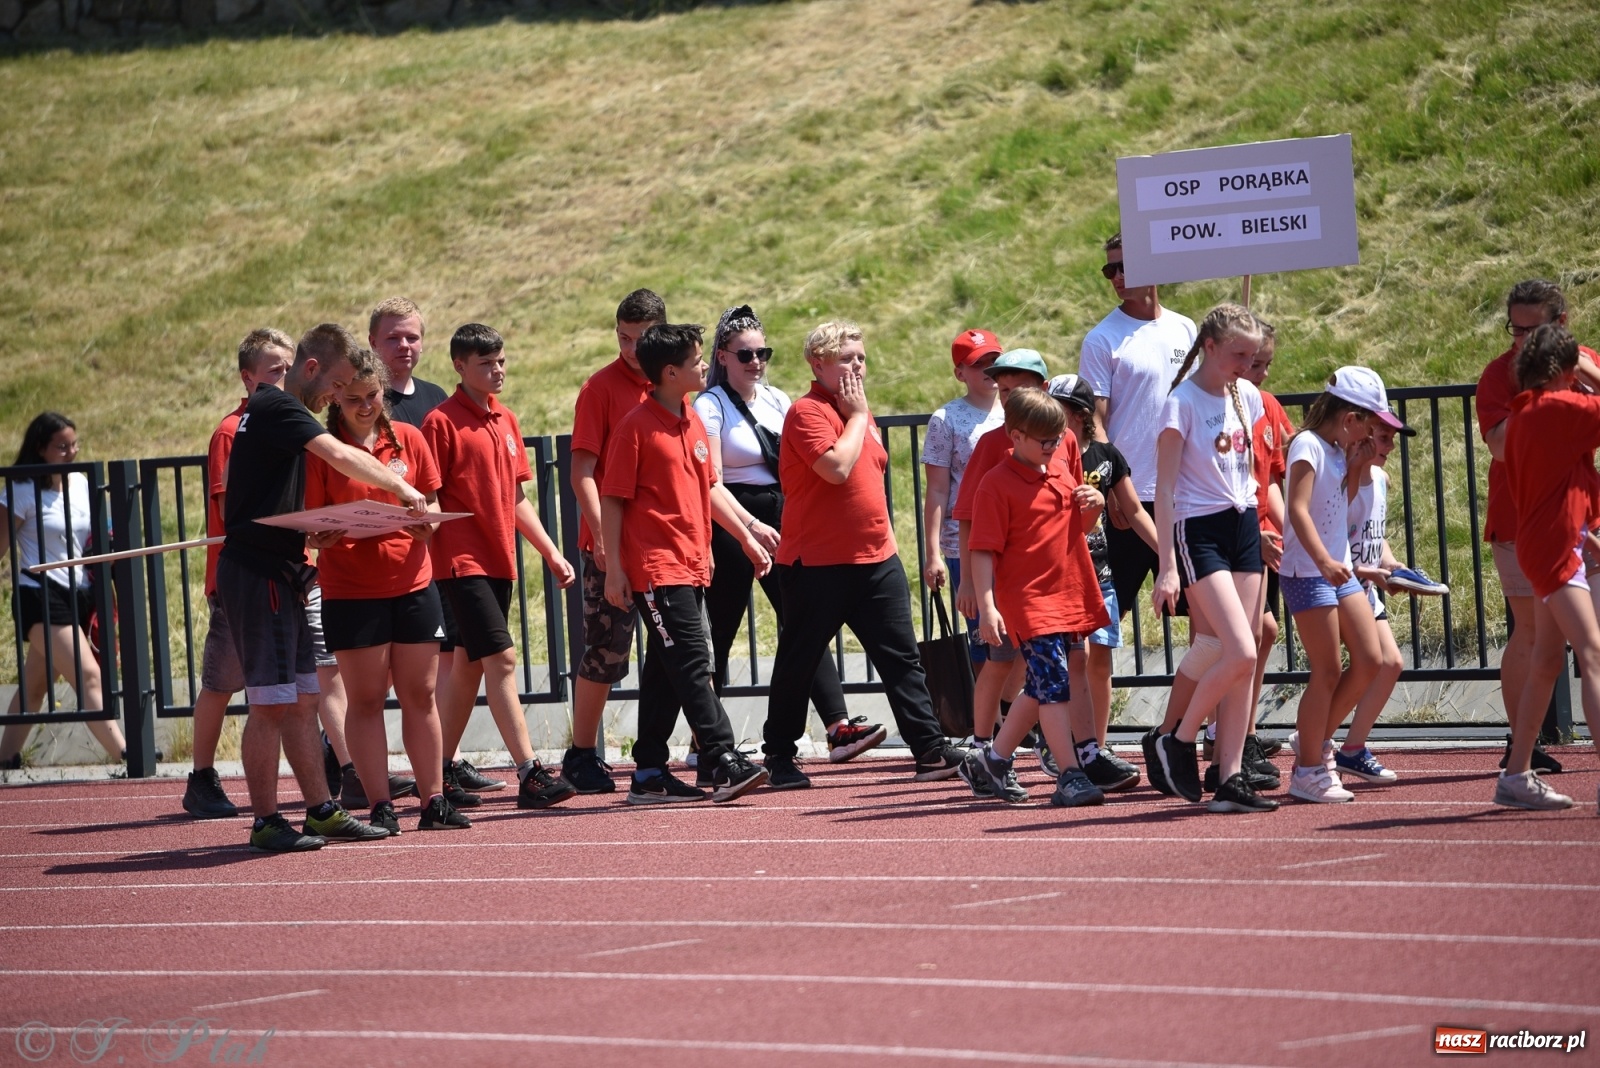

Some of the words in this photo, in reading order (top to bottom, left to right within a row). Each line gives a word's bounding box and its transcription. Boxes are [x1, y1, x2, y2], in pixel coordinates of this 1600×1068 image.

[1164, 179, 1200, 197] OSP
[1219, 169, 1309, 192] PORĄBKA
[1170, 222, 1222, 241] POW.
[1241, 214, 1307, 235] BIELSKI
